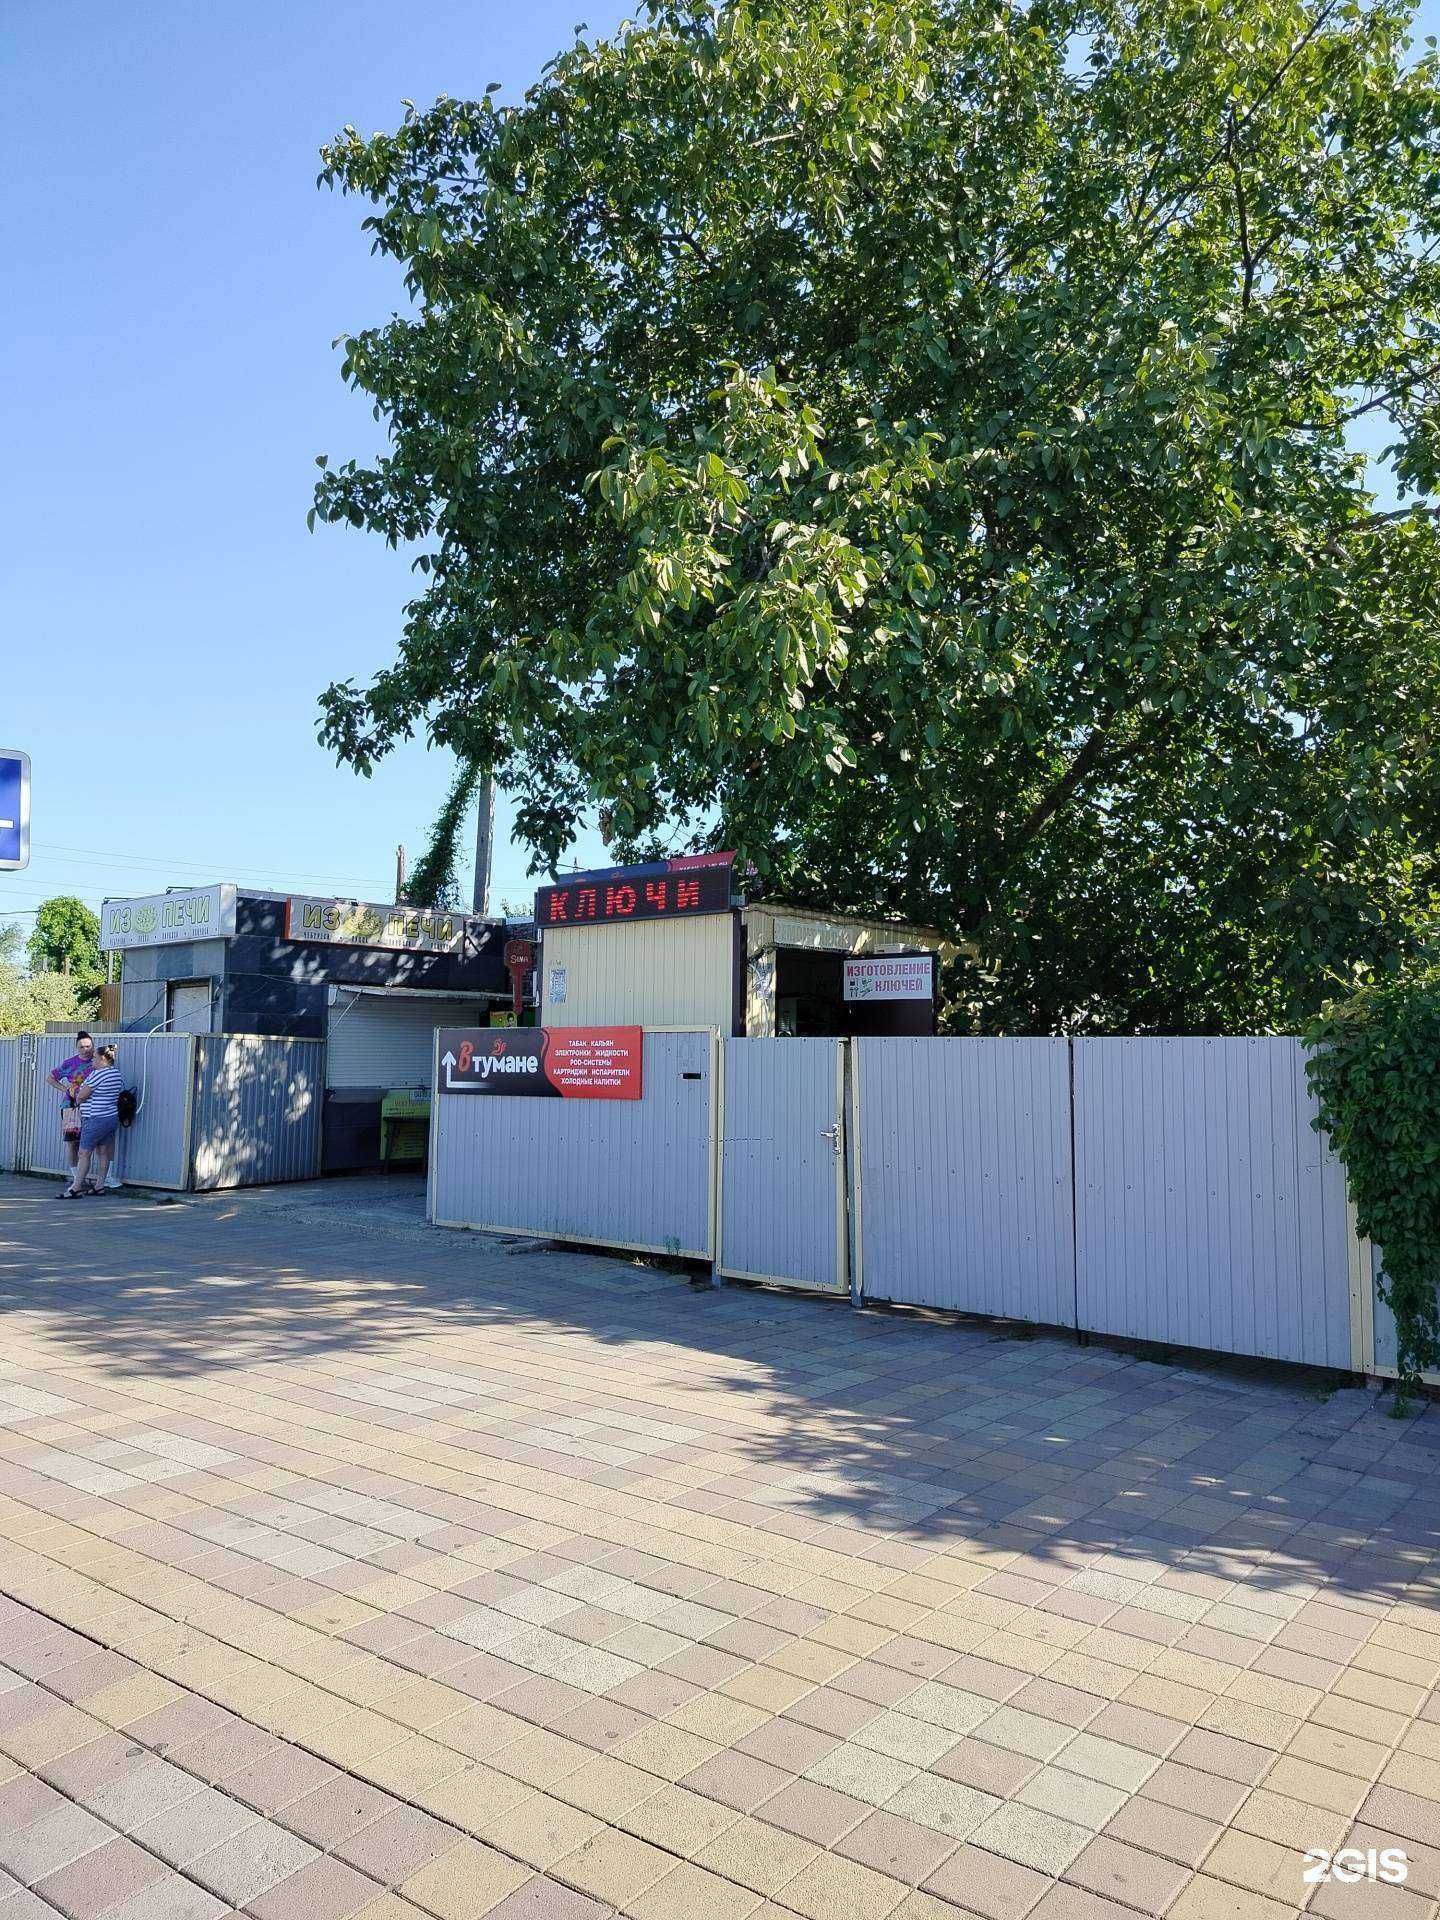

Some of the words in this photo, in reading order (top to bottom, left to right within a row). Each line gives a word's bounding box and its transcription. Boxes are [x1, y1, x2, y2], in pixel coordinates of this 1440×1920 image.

[550, 879, 699, 921] КЛЮЧИ
[110, 907, 131, 934] ИЗ
[162, 895, 210, 928] ПЕЧИ
[303, 904, 340, 930] ИЗ
[388, 913, 453, 941] ПЕЧИ
[847, 963, 931, 977] ИЗГОТОВЛЕНИЕ
[875, 978, 923, 992] КЛЮЧЕЙ
[594, 1049, 629, 1057] ЖИДКОСТИ
[472, 1056, 539, 1078] тумане
[553, 1068, 588, 1076] КАРТРИДЖИ
[591, 1068, 630, 1076] ИСПАРИТЕЛИ
[561, 1078, 593, 1086] ХОЛОДНЫЕ
[593, 1078, 621, 1086] НАПИТКИ
